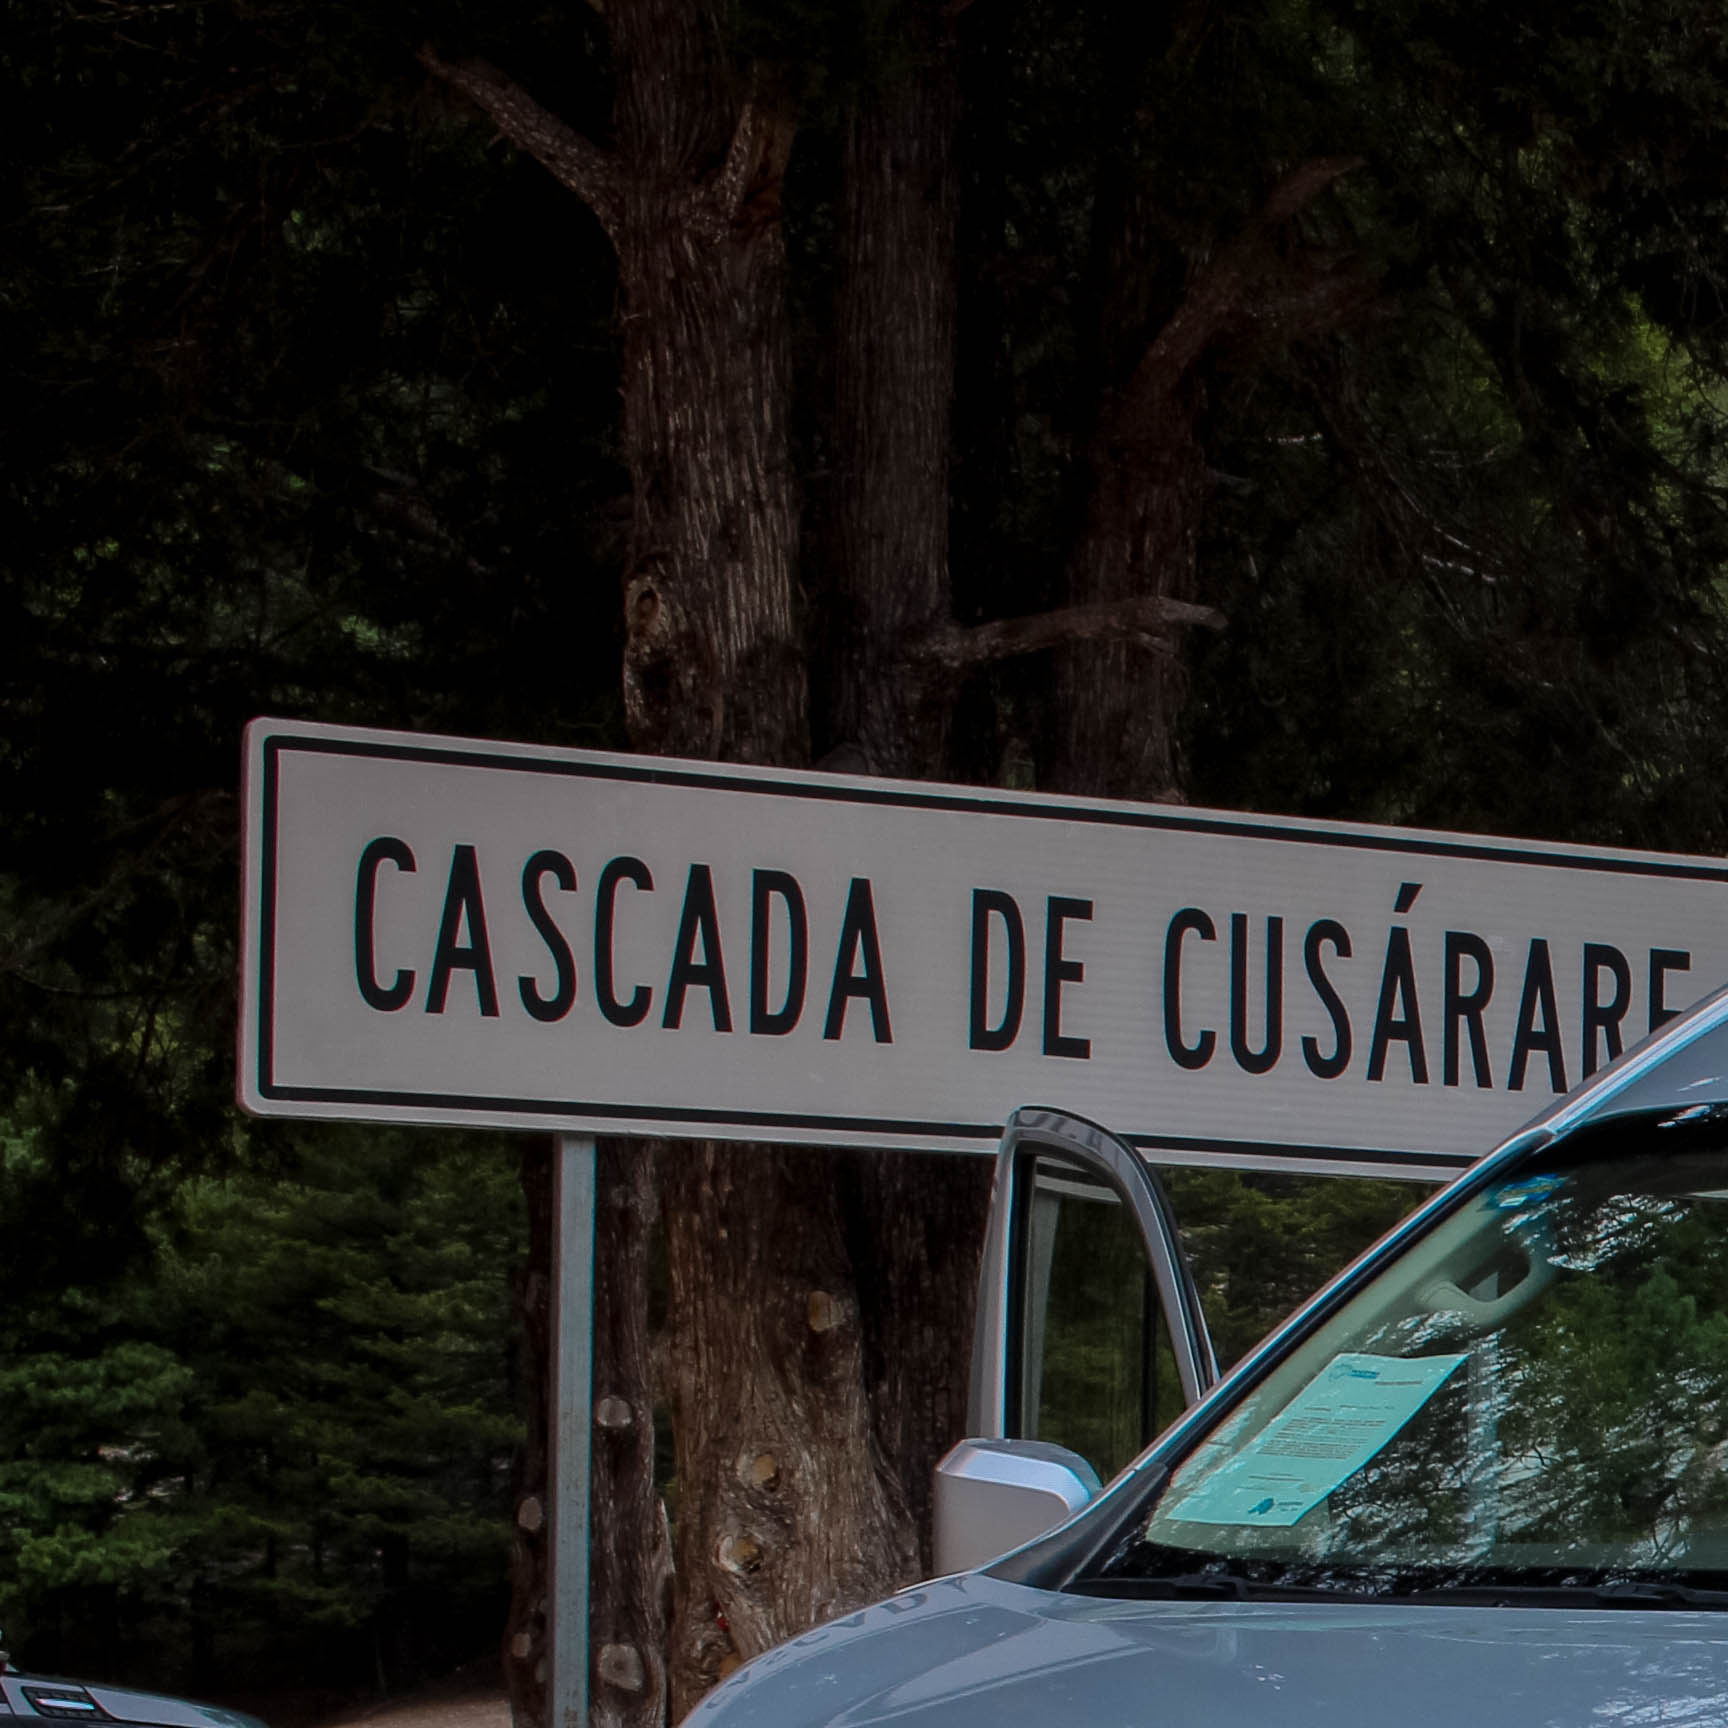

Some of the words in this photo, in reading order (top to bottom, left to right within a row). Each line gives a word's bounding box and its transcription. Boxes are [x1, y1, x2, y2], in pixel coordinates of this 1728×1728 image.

[355, 837, 893, 1043] CASCADA
[969, 887, 1094, 1060] DE
[1163, 882, 1691, 1094] CUSÁRARE
